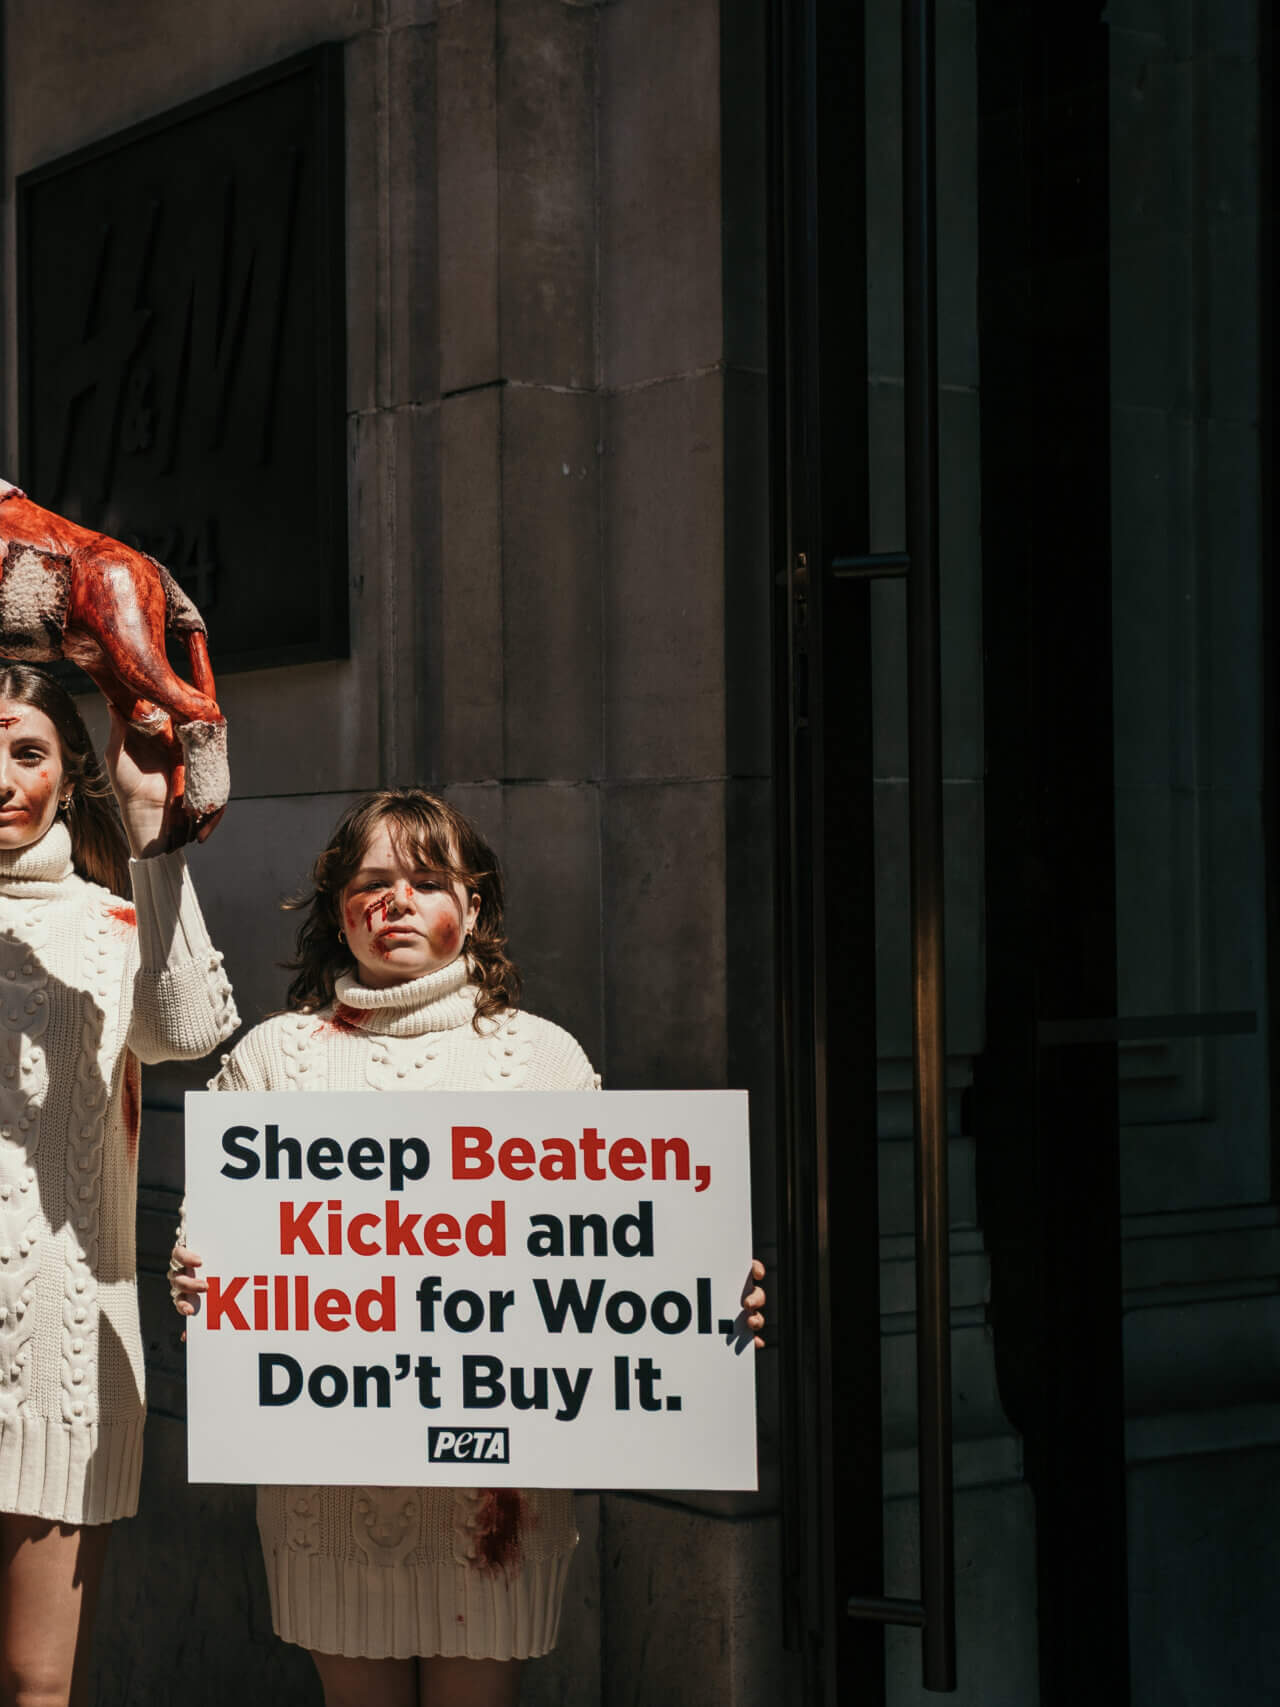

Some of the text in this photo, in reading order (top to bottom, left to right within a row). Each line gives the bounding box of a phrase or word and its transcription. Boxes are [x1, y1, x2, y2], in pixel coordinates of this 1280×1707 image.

[221, 1125, 711, 1192] Sheep Beaten,
[280, 1200, 654, 1257] Kicked and
[206, 1275, 733, 1334] Killed for Wool.
[259, 1353, 682, 1421] Don’t Buy It.
